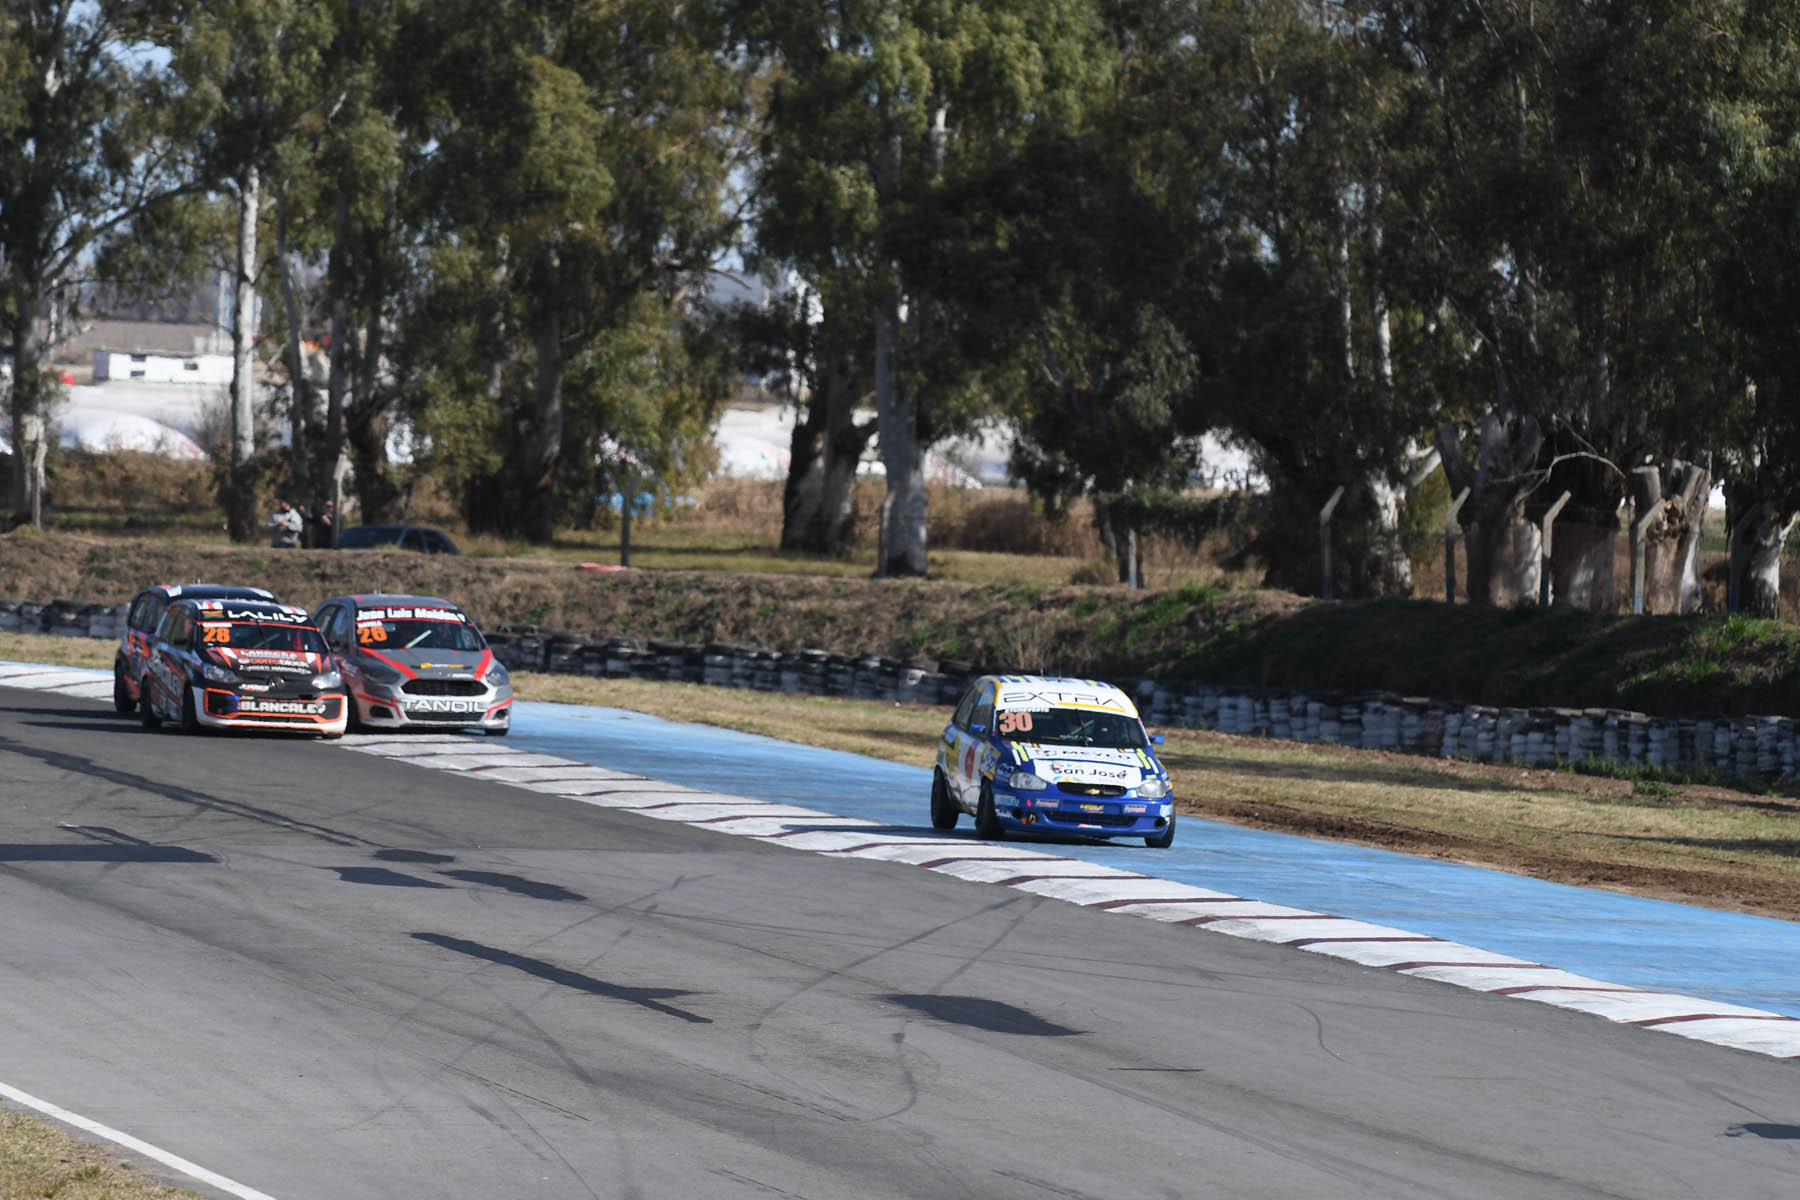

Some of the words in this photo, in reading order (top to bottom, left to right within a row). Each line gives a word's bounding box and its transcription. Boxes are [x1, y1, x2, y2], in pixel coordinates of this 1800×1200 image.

[227, 609, 308, 623] LALILY
[387, 607, 413, 618] Luis
[203, 627, 231, 643] 28
[356, 625, 388, 644] 26
[402, 700, 487, 712] TANDIL
[1003, 691, 1126, 709] EXTRA
[999, 712, 1033, 733] 30
[1051, 763, 1085, 776] San
